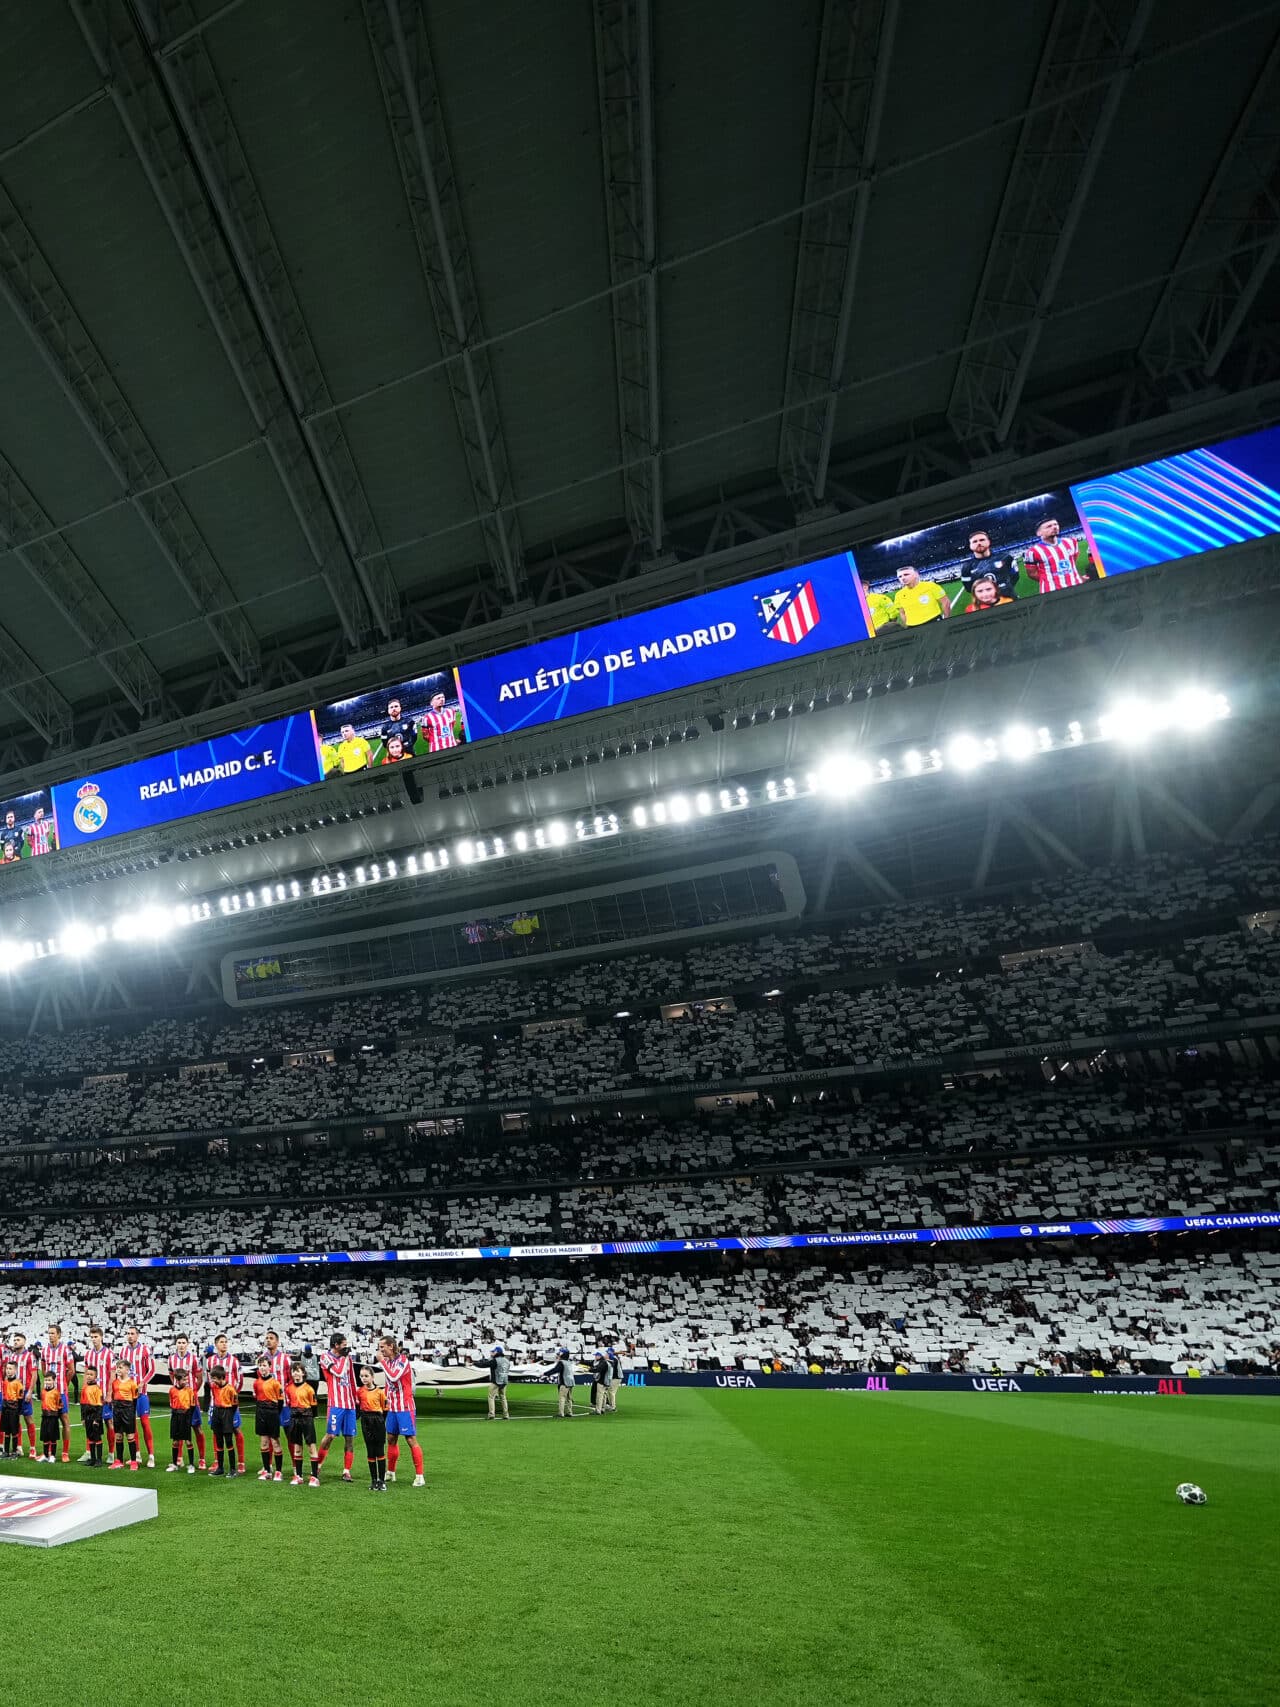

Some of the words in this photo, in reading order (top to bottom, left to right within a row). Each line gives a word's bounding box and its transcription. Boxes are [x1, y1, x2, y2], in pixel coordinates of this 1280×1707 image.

[499, 659, 600, 702] ATLÉTICO
[604, 649, 636, 673] DE
[639, 621, 738, 664] MADRID
[139, 778, 177, 801] REAL
[179, 760, 242, 790] MADRID
[244, 755, 261, 771] C.
[263, 750, 277, 766] F.
[772, 1075, 793, 1084] Real
[795, 1071, 829, 1081] Madrid
[1184, 1218, 1215, 1227] UEFA
[1216, 1215, 1280, 1226] CHAMPION
[1038, 1225, 1071, 1233] PEPSI
[807, 1236, 829, 1245] UEFA
[830, 1234, 882, 1243] CHAMPIONS
[883, 1232, 918, 1241] LEAGUE
[627, 1374, 646, 1387] ALL
[715, 1376, 757, 1388] UEFA
[866, 1377, 889, 1391] ALL
[971, 1378, 1022, 1392] UEFA
[1158, 1379, 1186, 1395] ALL
[331, 1414, 337, 1424] 5
